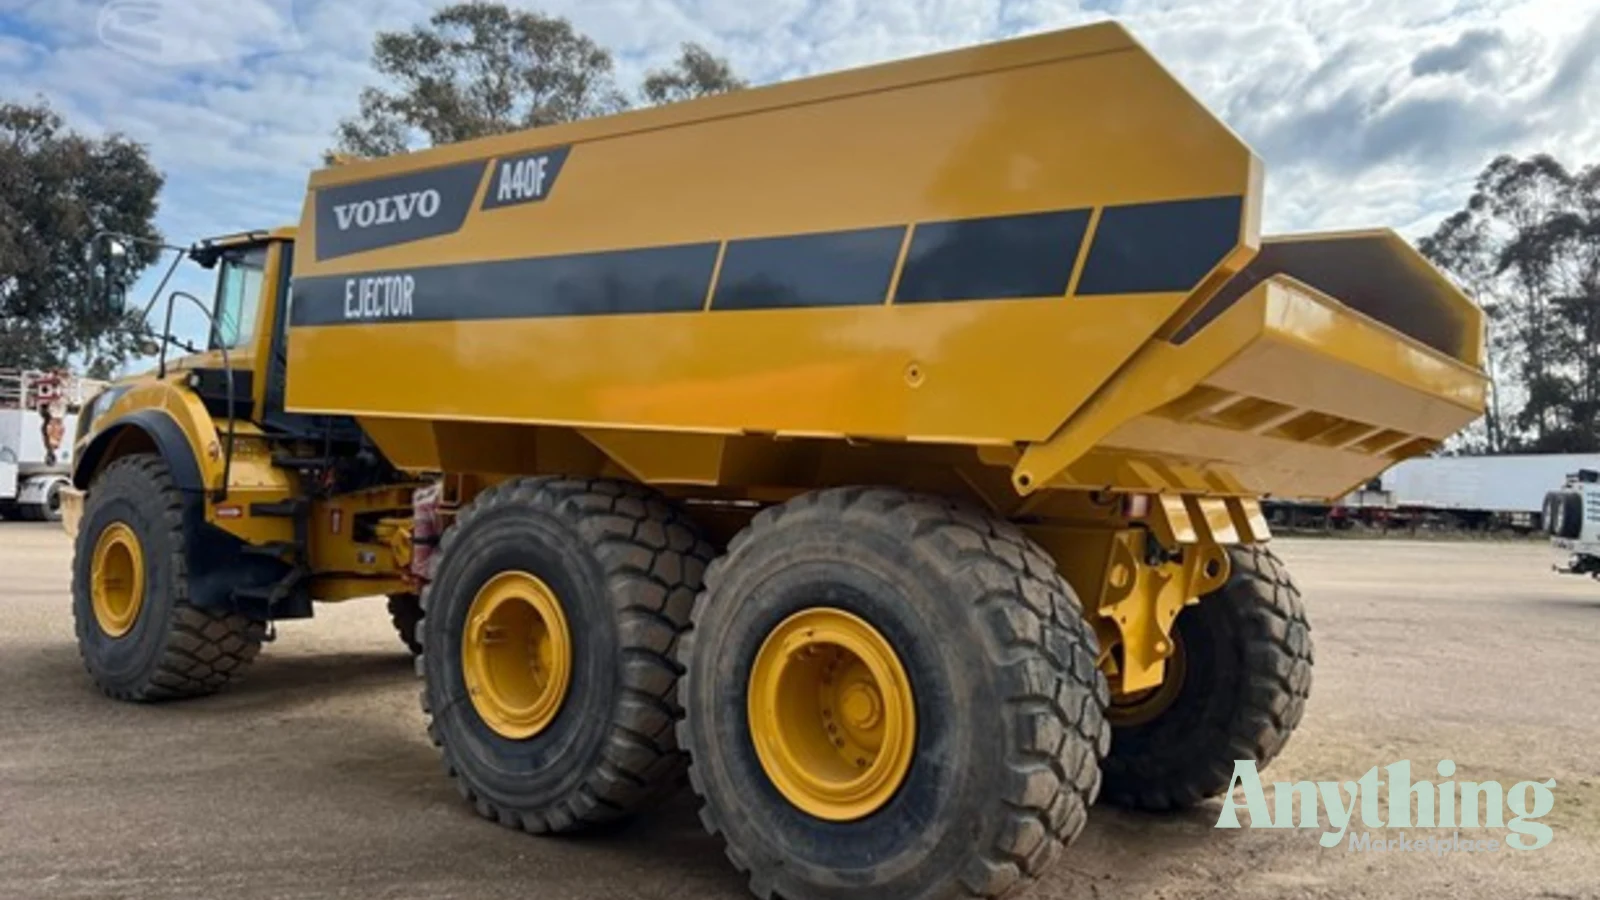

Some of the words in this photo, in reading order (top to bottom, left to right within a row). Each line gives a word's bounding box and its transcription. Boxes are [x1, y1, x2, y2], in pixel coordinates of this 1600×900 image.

[497, 156, 548, 201] A40F
[333, 189, 441, 230] VOLVO
[344, 275, 415, 318] EJECTOR
